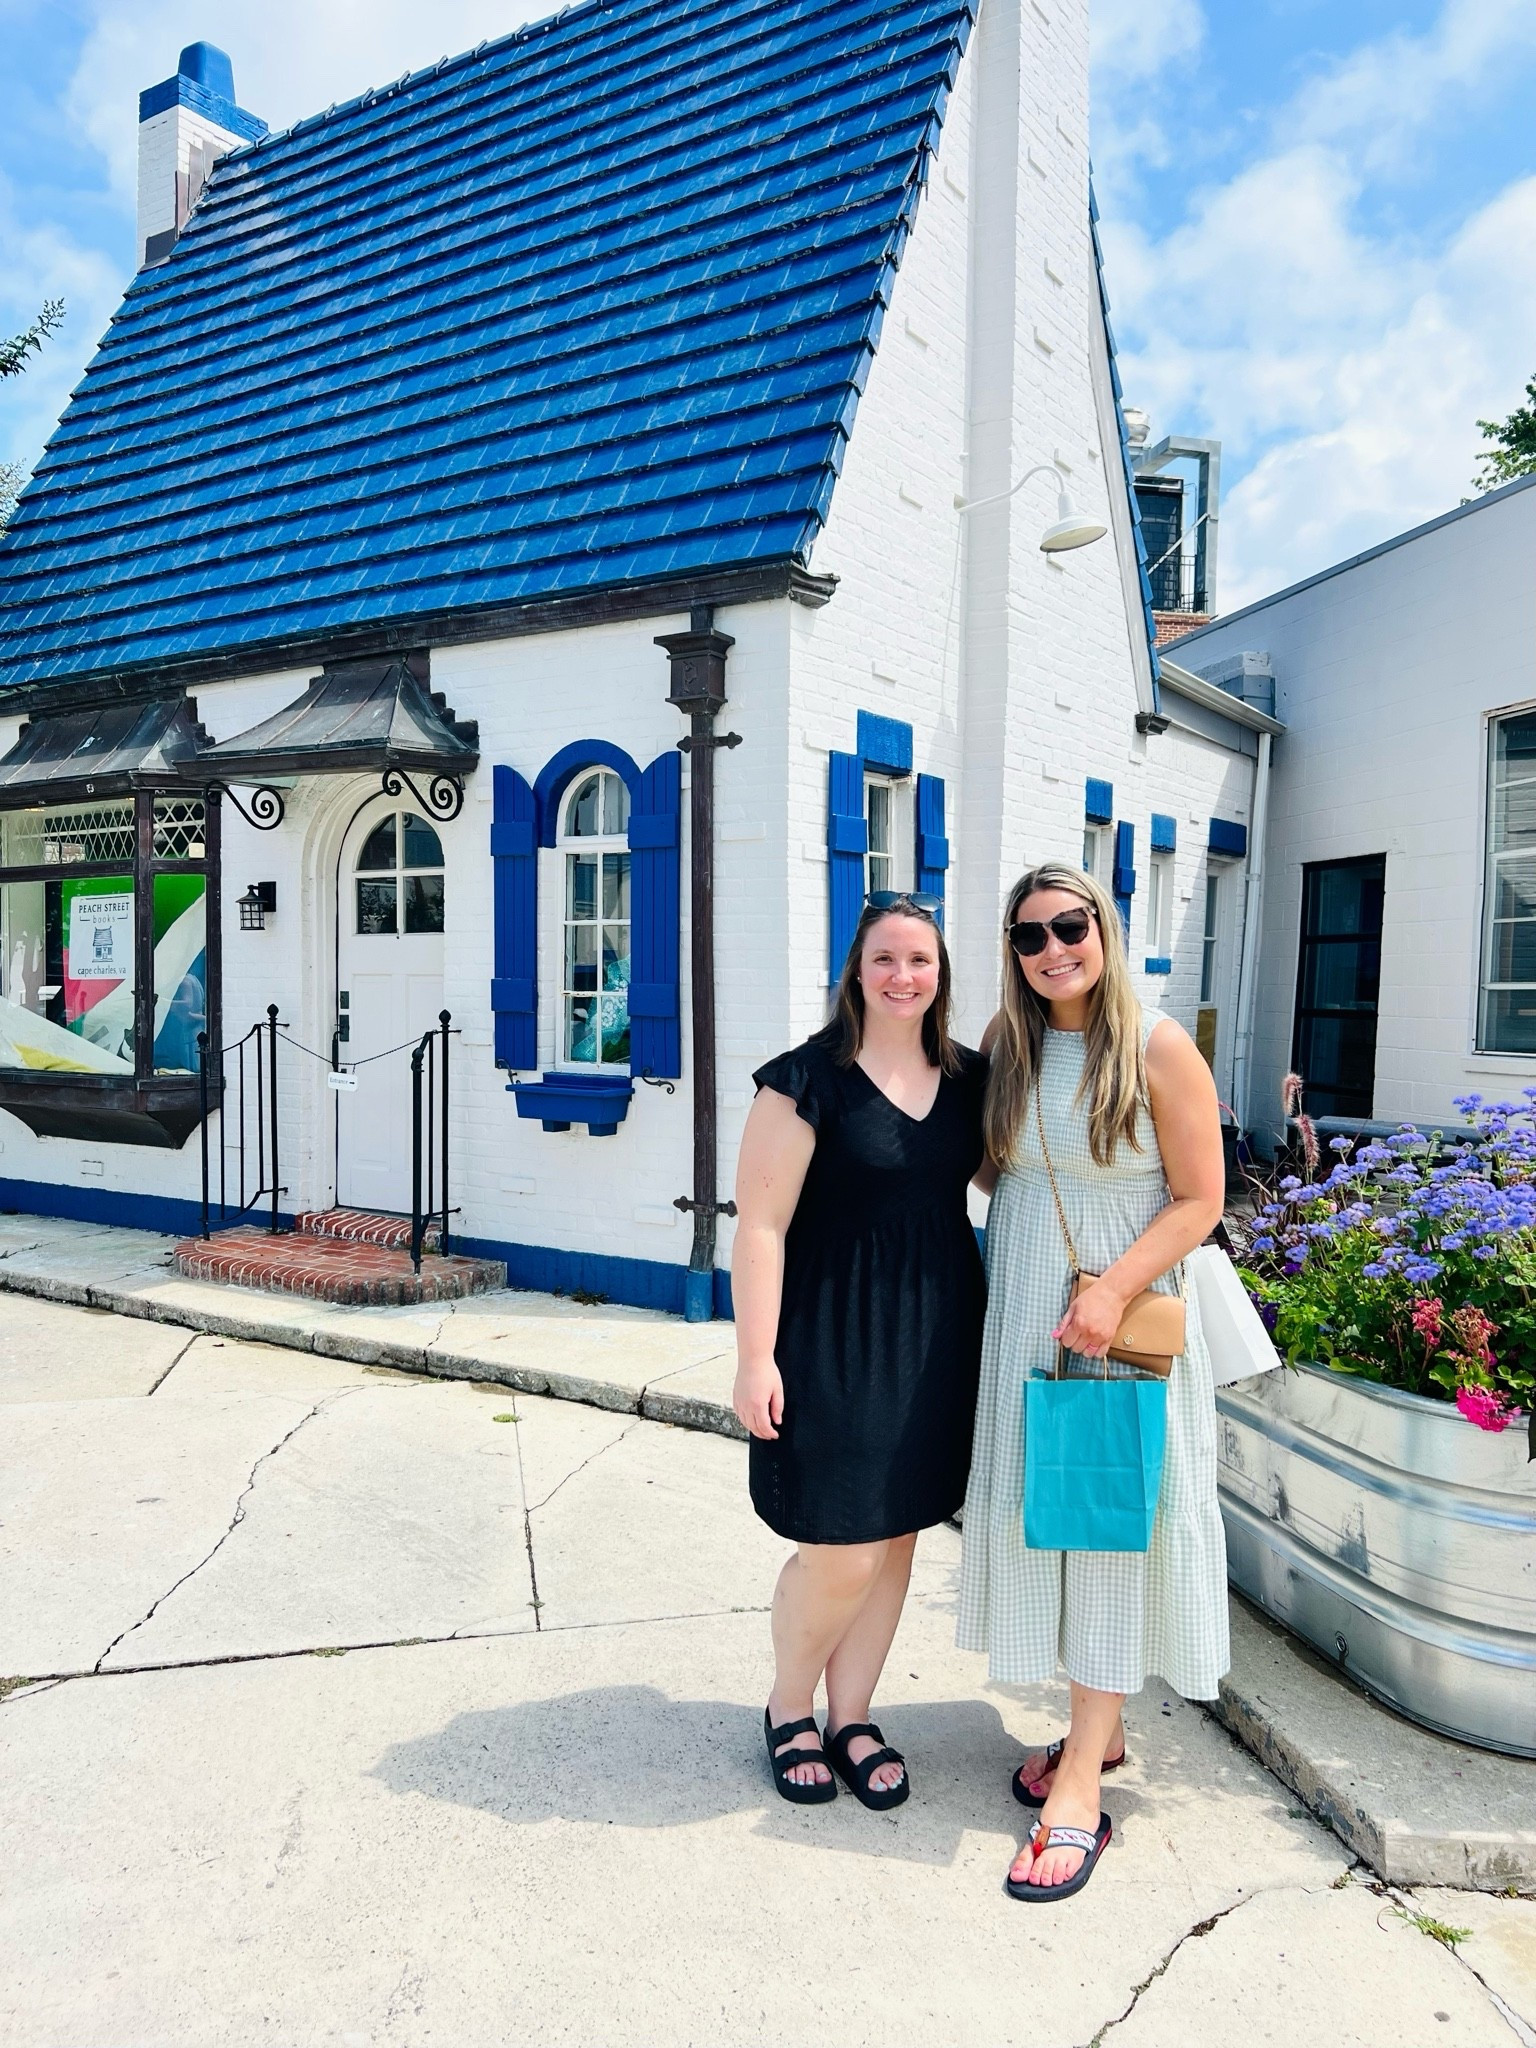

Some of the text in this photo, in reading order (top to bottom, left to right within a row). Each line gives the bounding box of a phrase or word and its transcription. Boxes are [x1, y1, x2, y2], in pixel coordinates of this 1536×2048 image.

[78, 902, 130, 913] PEACH STREET
[92, 914, 116, 924] books
[77, 968, 92, 978] cape
[93, 965, 118, 975] charles,
